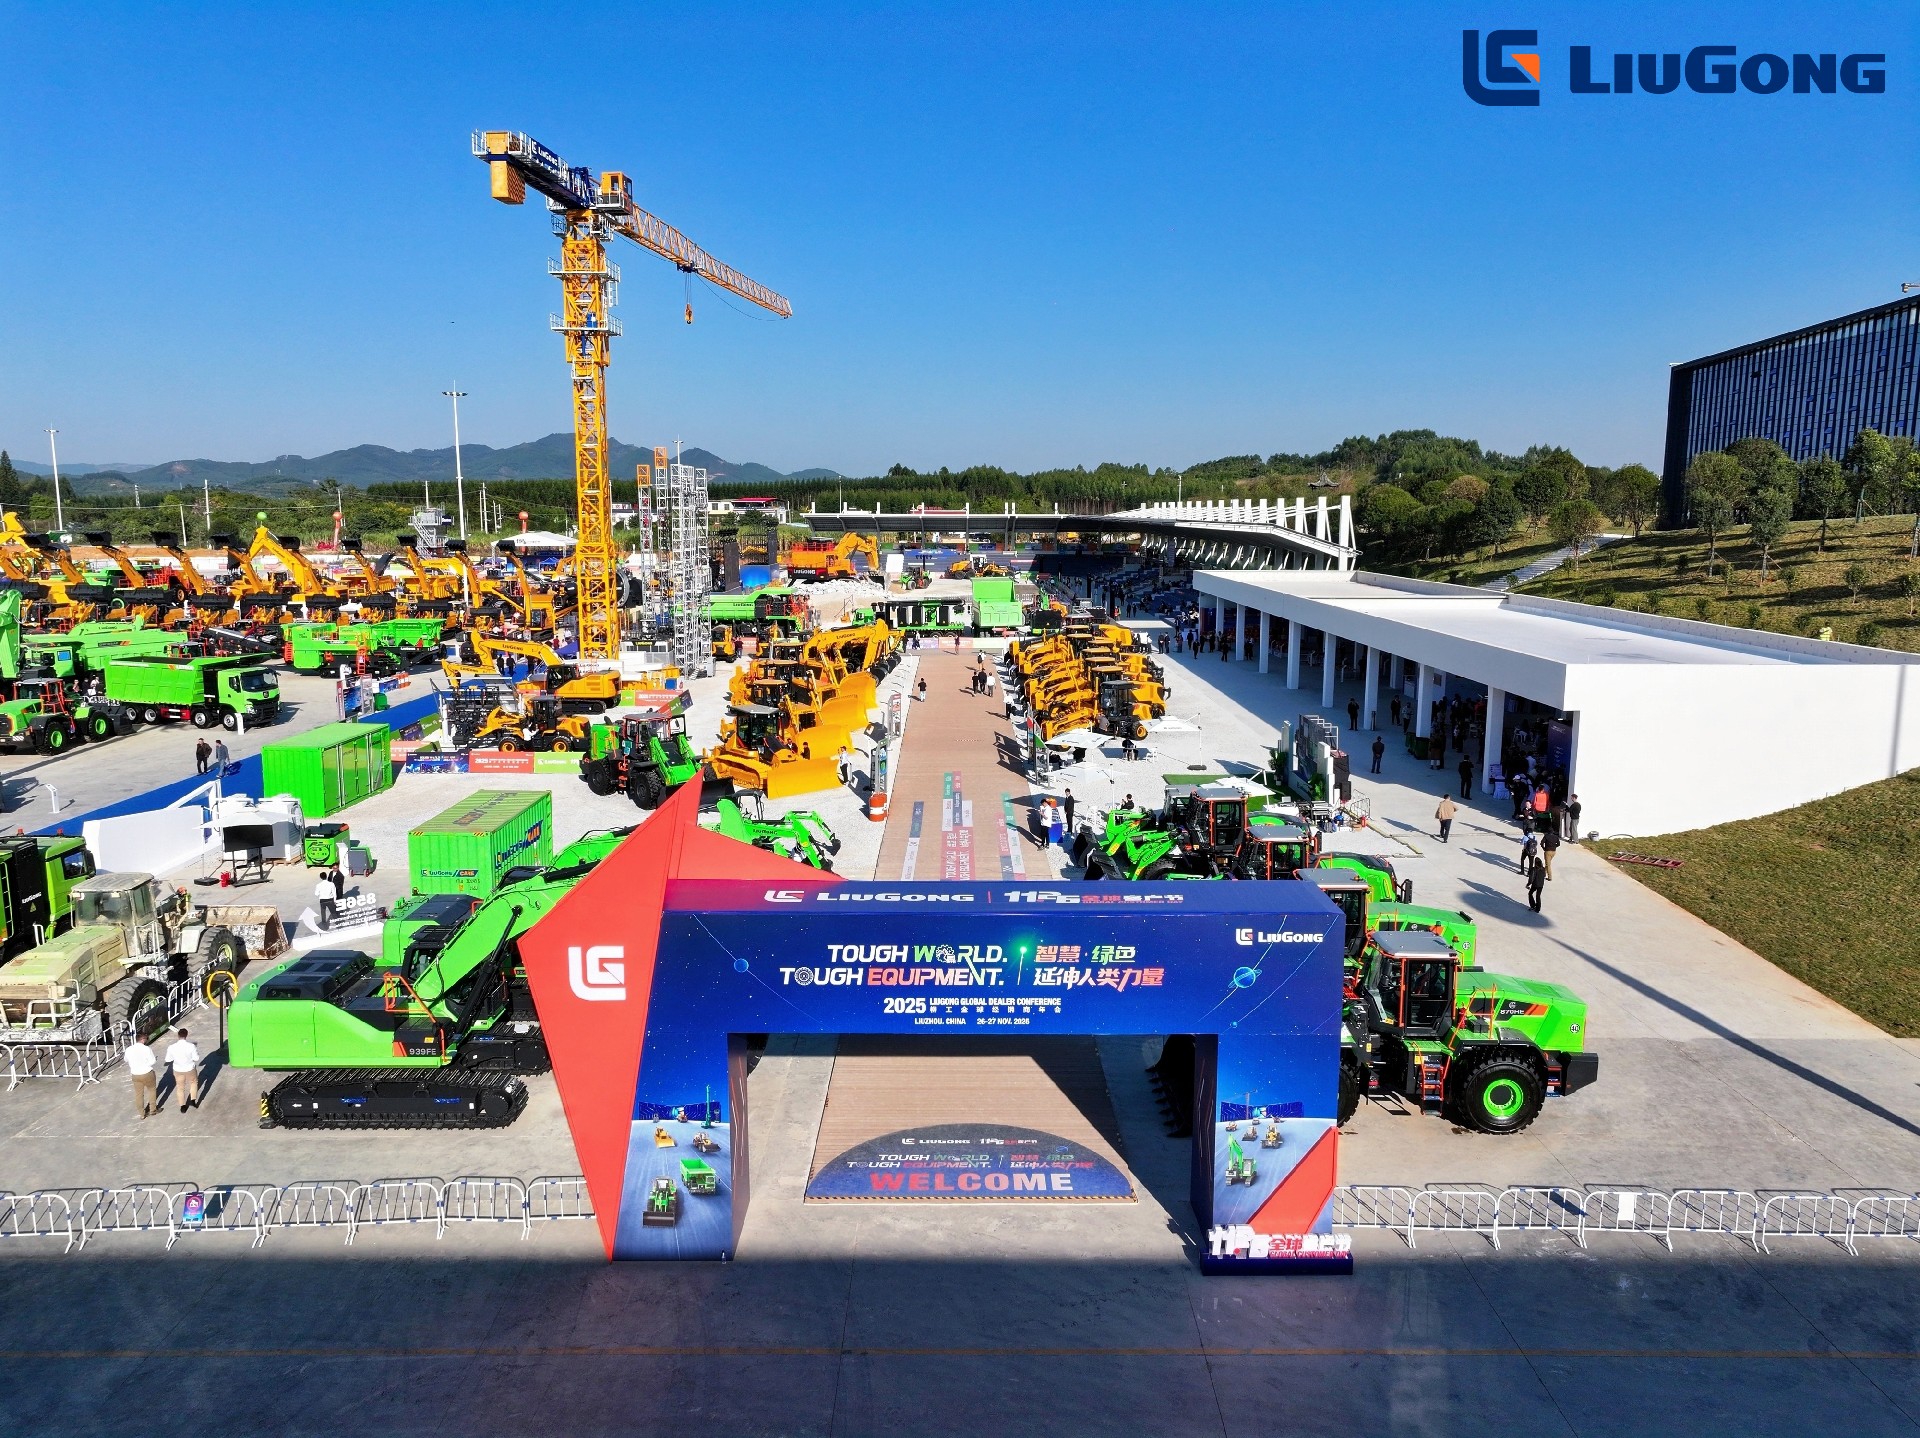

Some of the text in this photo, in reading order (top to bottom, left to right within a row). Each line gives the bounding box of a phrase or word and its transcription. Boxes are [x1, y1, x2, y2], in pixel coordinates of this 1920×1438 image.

[827, 944, 909, 963] TOUGH
[779, 966, 1004, 986] TOUGH EQUIPMENT.
[1033, 966, 1165, 993] 延伸人类力量
[883, 997, 927, 1014] 2025
[960, 997, 987, 1006] GLOBAL
[988, 997, 1016, 1006] DEALER
[1016, 997, 1062, 1006] CONFERENCE
[409, 1048, 437, 1056] 939FE
[878, 1153, 931, 1161] TOUGH
[869, 1172, 1074, 1191] WELCOME
